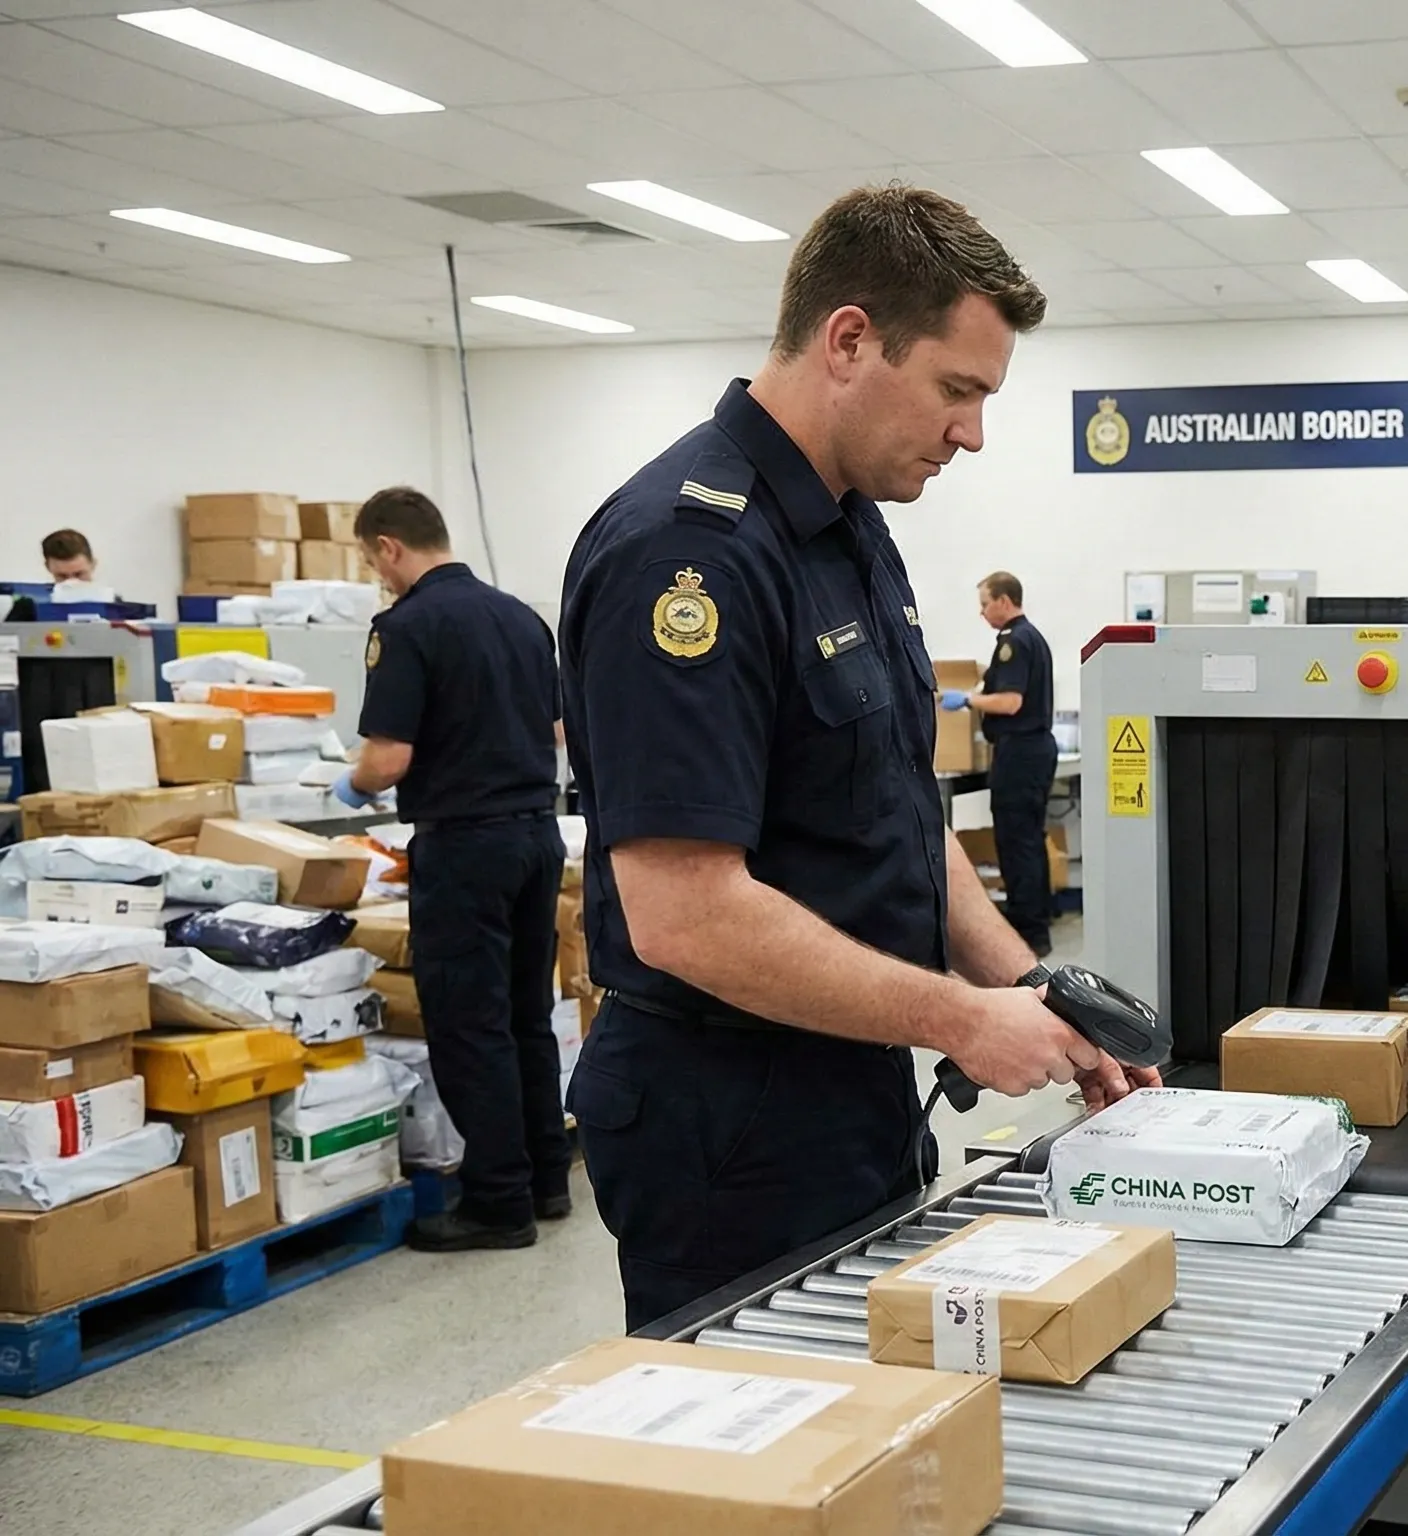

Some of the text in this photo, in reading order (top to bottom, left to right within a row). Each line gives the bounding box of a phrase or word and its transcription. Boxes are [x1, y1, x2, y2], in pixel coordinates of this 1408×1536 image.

[1144, 412, 1296, 443] AUSTRALIAN
[1302, 409, 1404, 440] BORDER
[1111, 1177, 1255, 1204] CHINA POST
